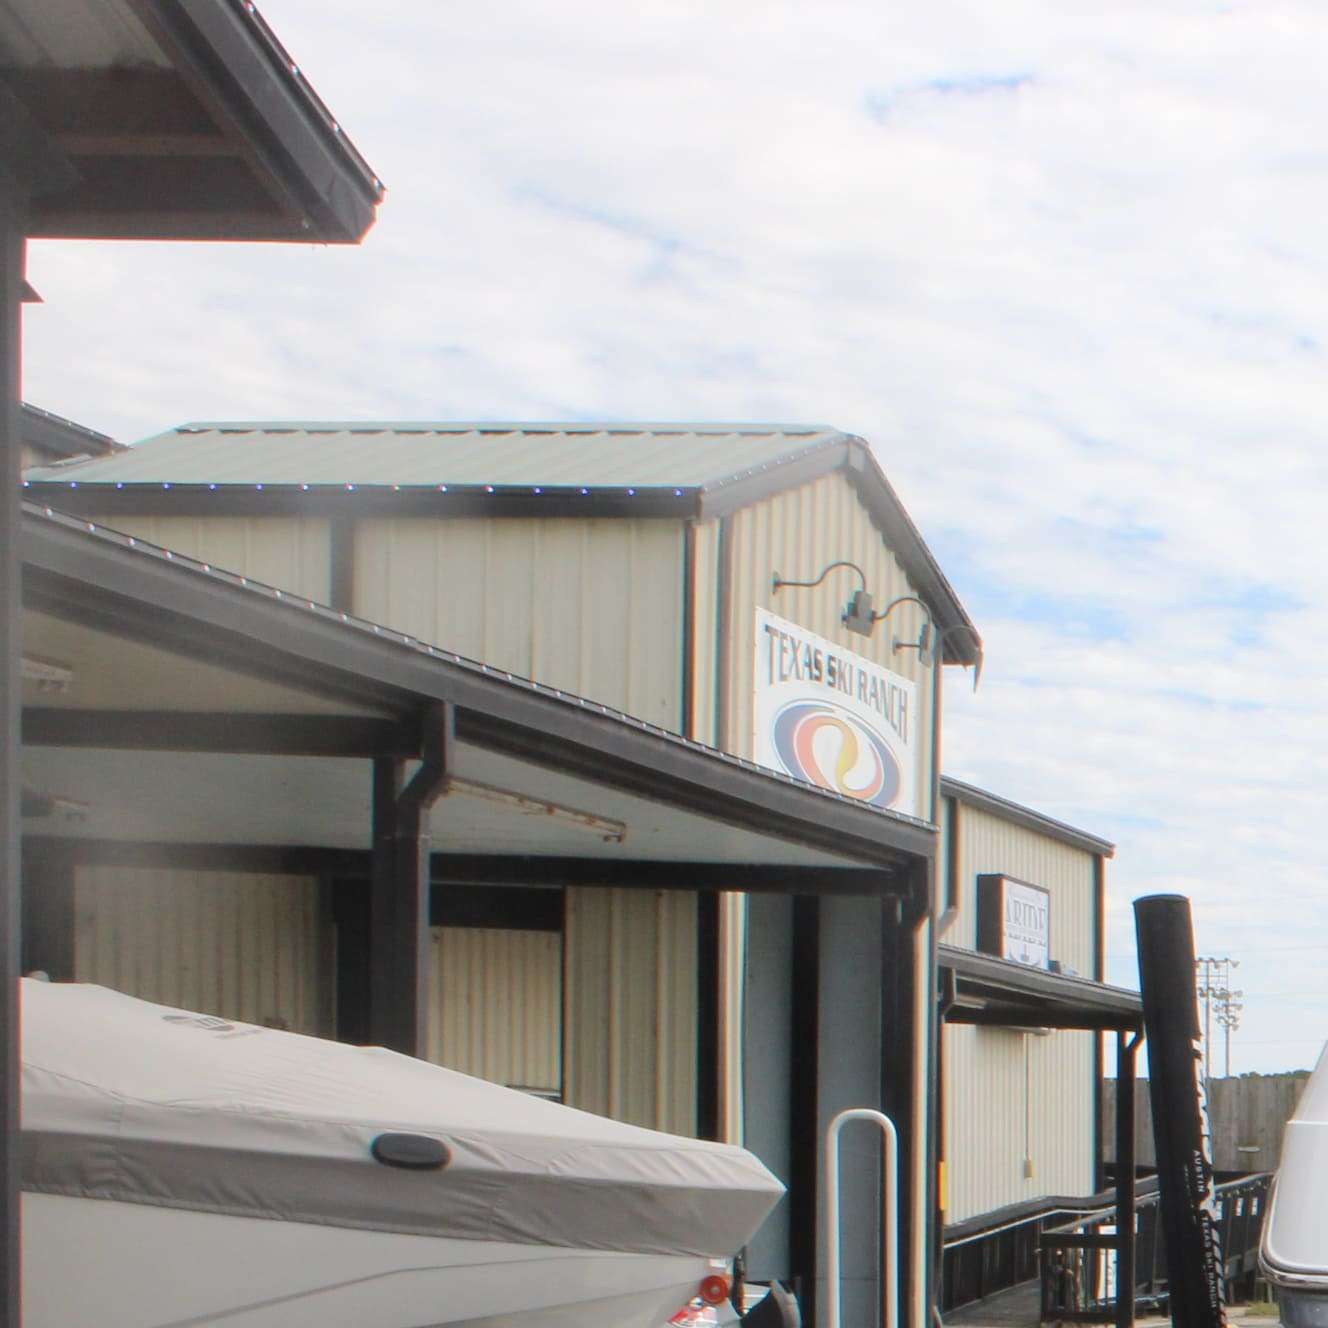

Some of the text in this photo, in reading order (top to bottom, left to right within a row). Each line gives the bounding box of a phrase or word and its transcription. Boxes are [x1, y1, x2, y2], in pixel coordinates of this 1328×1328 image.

[764, 624, 908, 745] TEXAS SKI RANCH
[1192, 1149, 1205, 1194] AUSTIN
[1201, 1216, 1217, 1309] TEXAS SKI RANCH
